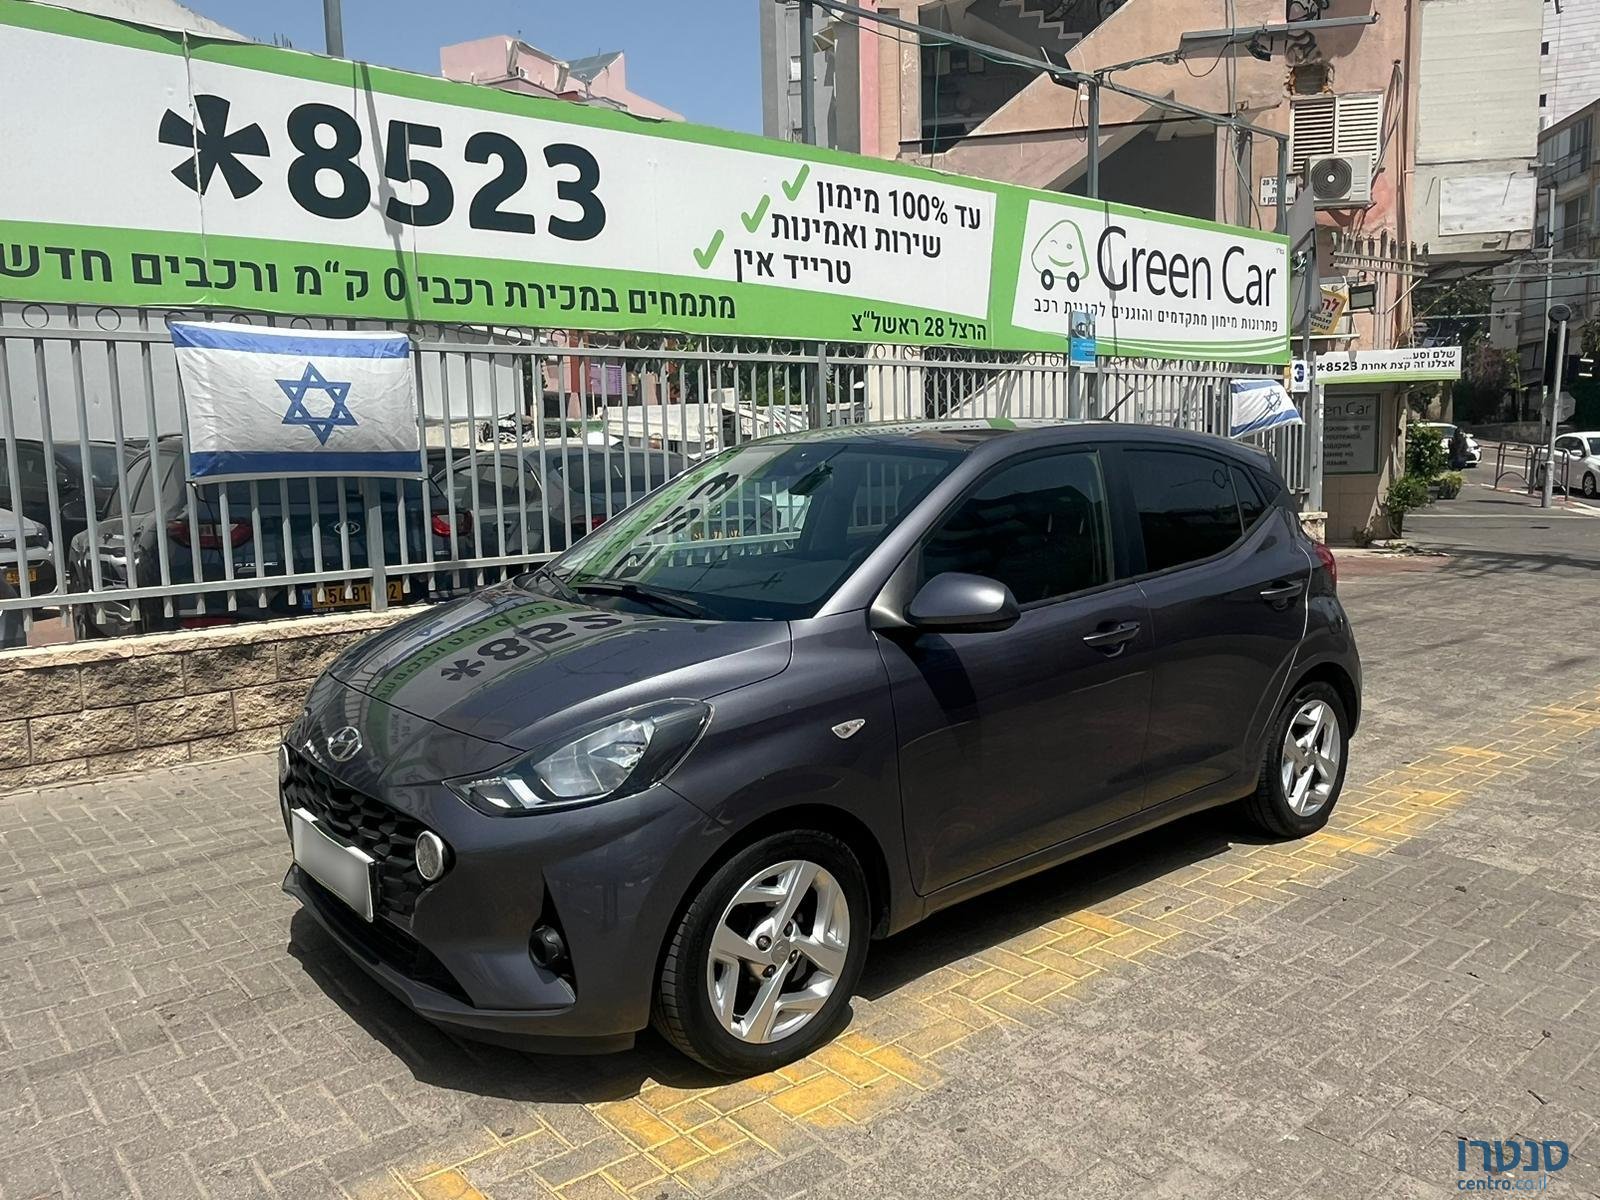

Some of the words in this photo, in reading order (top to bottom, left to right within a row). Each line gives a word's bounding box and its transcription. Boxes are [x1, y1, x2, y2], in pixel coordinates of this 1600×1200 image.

[816, 180, 880, 214] מימון
[888, 189, 949, 225] 100%
[955, 204, 981, 230] עד
[771, 213, 867, 249] ואמינות
[875, 227, 941, 258] שירות
[131, 252, 279, 293] ורכבים
[734, 248, 775, 282] אין
[783, 253, 851, 285] טרייד
[1096, 225, 1212, 301] Green
[1222, 245, 1277, 307] Car
[383, 267, 407, 302] 0
[417, 275, 494, 306] רכבי
[504, 281, 620, 313] במכירת
[628, 289, 736, 319] מתמחים
[1033, 298, 1058, 314] רכב
[1111, 305, 1153, 323] והוגנים
[924, 316, 945, 338] 28
[949, 317, 987, 341] הרצל
[1157, 310, 1208, 328] מתקדמים
[1211, 314, 1238, 331] מימון
[1240, 317, 1278, 333] פתרונות
[1361, 361, 1388, 371] אחרת
[1389, 361, 1411, 371] קצת
[1413, 360, 1425, 369] זה
[1427, 359, 1456, 369] אצלנו
[1432, 350, 1456, 359] שלם
[1345, 401, 1371, 416] Car
